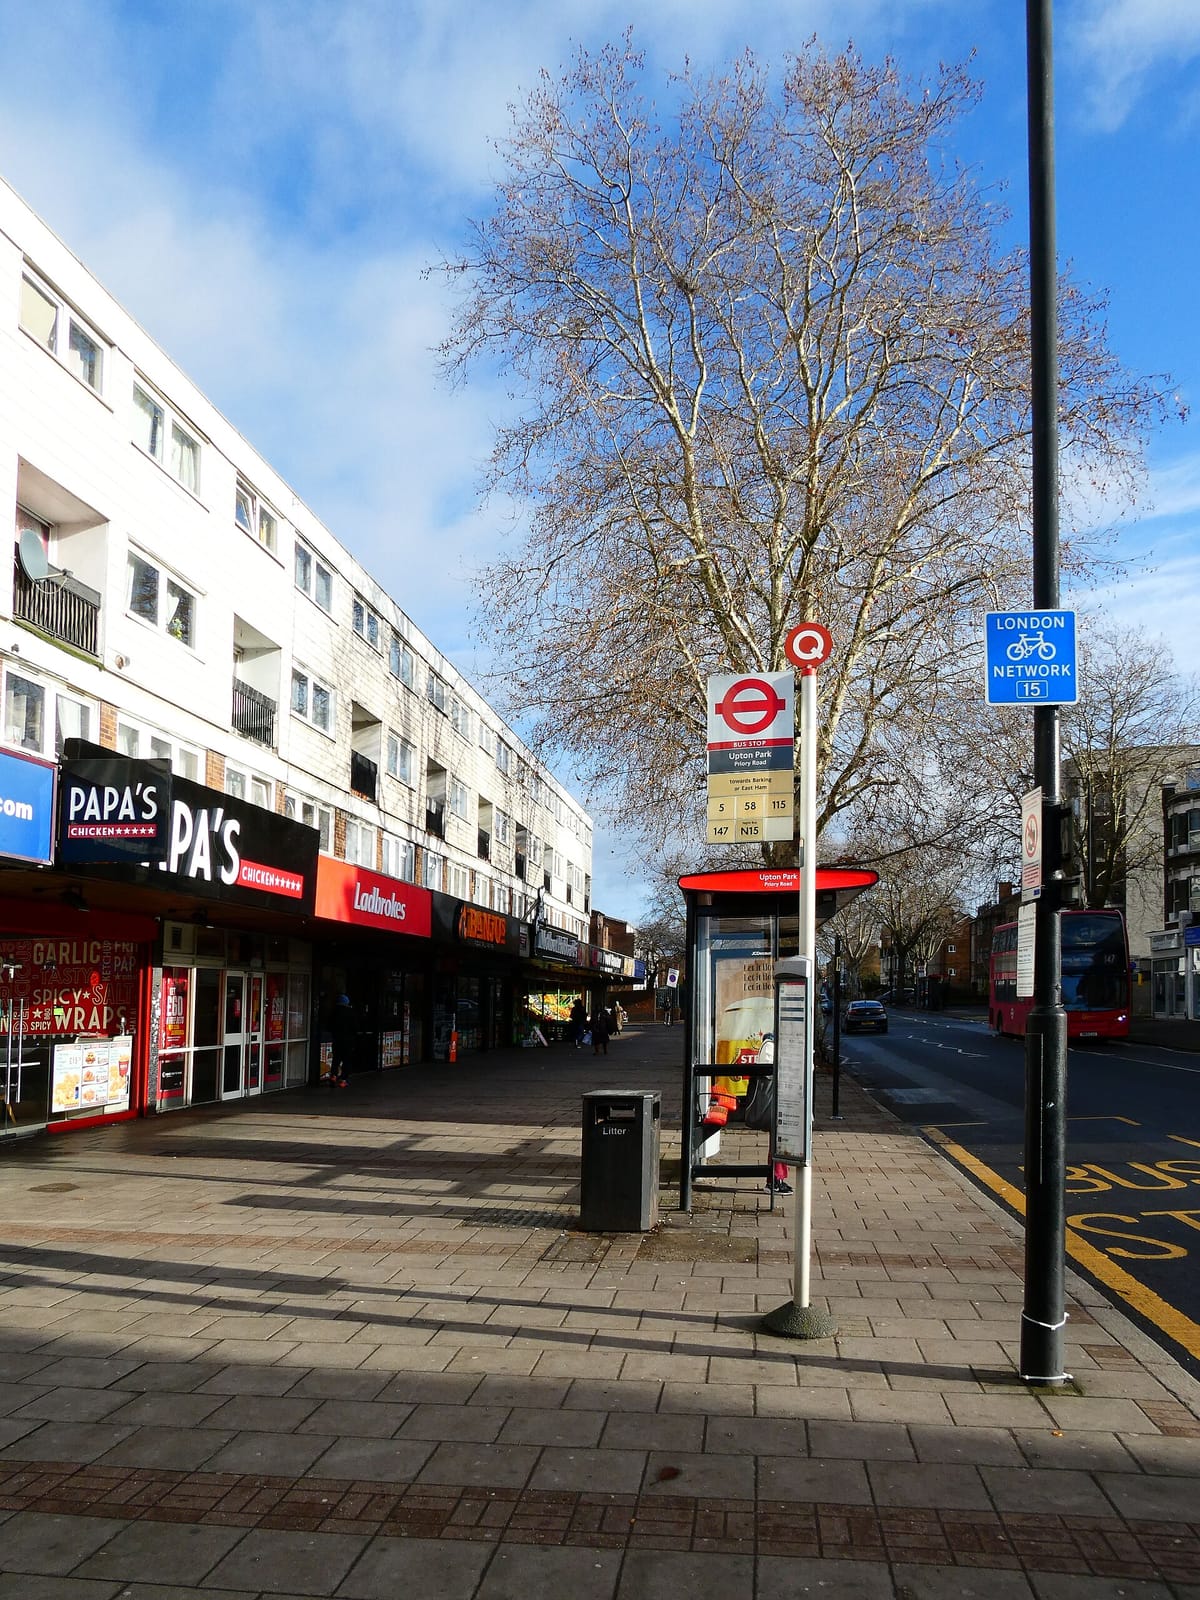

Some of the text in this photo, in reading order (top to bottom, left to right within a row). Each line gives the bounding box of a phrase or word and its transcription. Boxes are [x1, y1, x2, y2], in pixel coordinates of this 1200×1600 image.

[997, 616, 1065, 630] LONDON
[793, 630, 823, 659] Q
[993, 664, 1071, 678] NETWORK
[1023, 682, 1041, 697] 15
[728, 750, 772, 760] Upton Park
[69, 783, 158, 821] PAPA'S
[718, 800, 786, 812] 5 58 115
[70, 827, 115, 836] CHICKEN
[713, 826, 759, 836] 147 N15
[241, 866, 275, 886] CHICKEN
[759, 873, 781, 881] Upton
[353, 881, 406, 920] Ladbrokes
[33, 941, 101, 966] GARLIC
[102, 940, 112, 982] KETCHUP
[33, 988, 82, 1005] SPICY
[54, 1006, 127, 1030] WRAPS
[30, 1021, 52, 1031] SPICY
[602, 1127, 627, 1135] Litter
